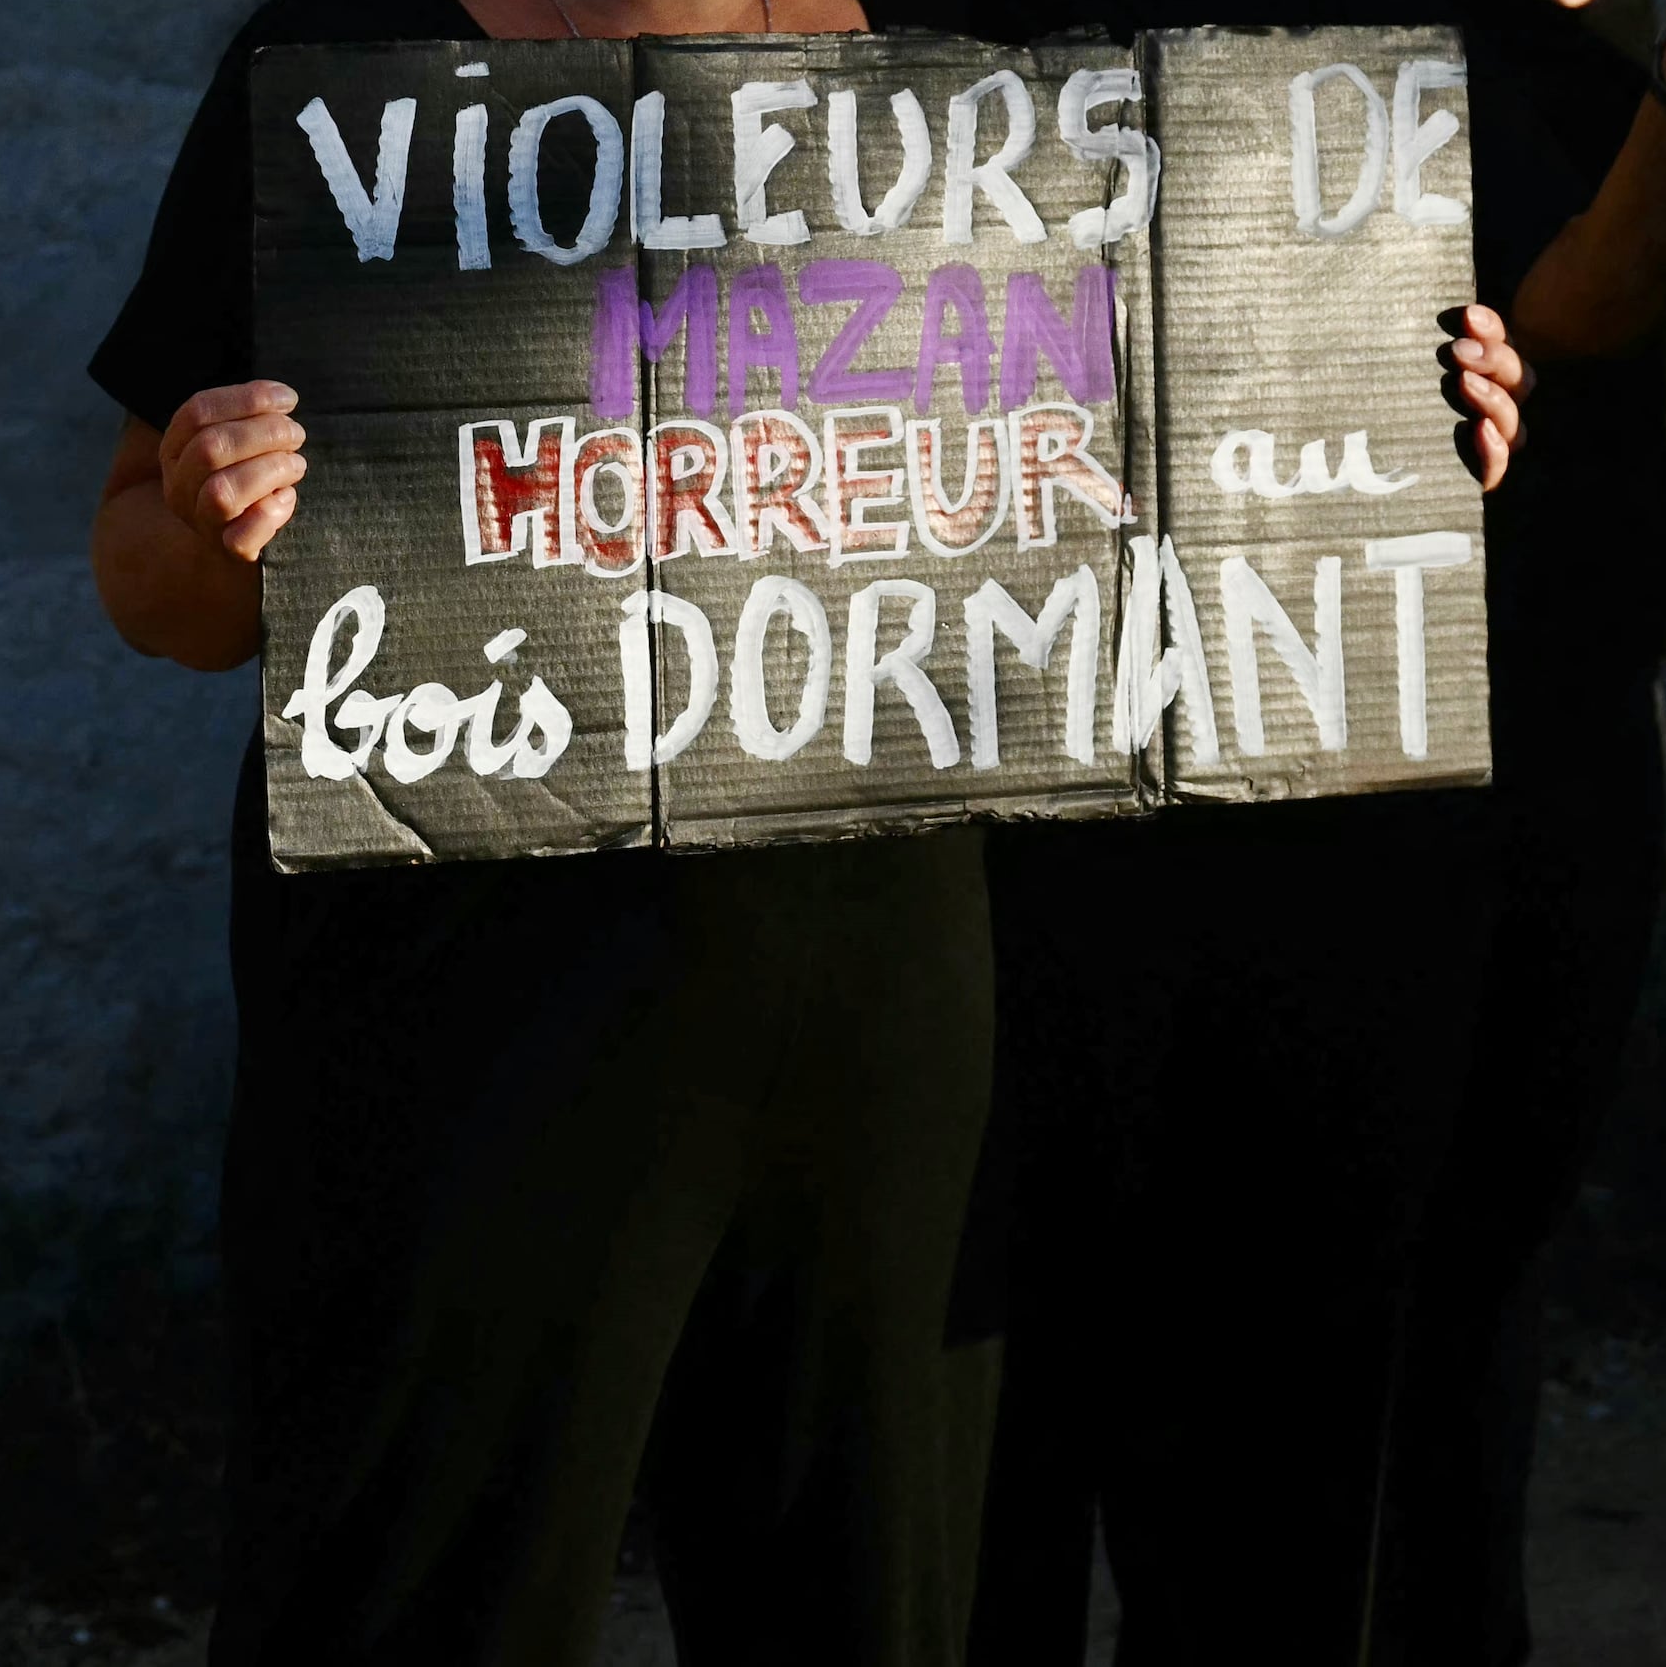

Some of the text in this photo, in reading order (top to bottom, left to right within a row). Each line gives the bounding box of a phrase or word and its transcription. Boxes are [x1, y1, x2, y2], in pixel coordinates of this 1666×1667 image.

[1290, 60, 1467, 237] DE
[589, 258, 1117, 417] MAZAN
[459, 403, 1419, 577] HORREUR au
[282, 534, 1473, 784] bois DORMANT
